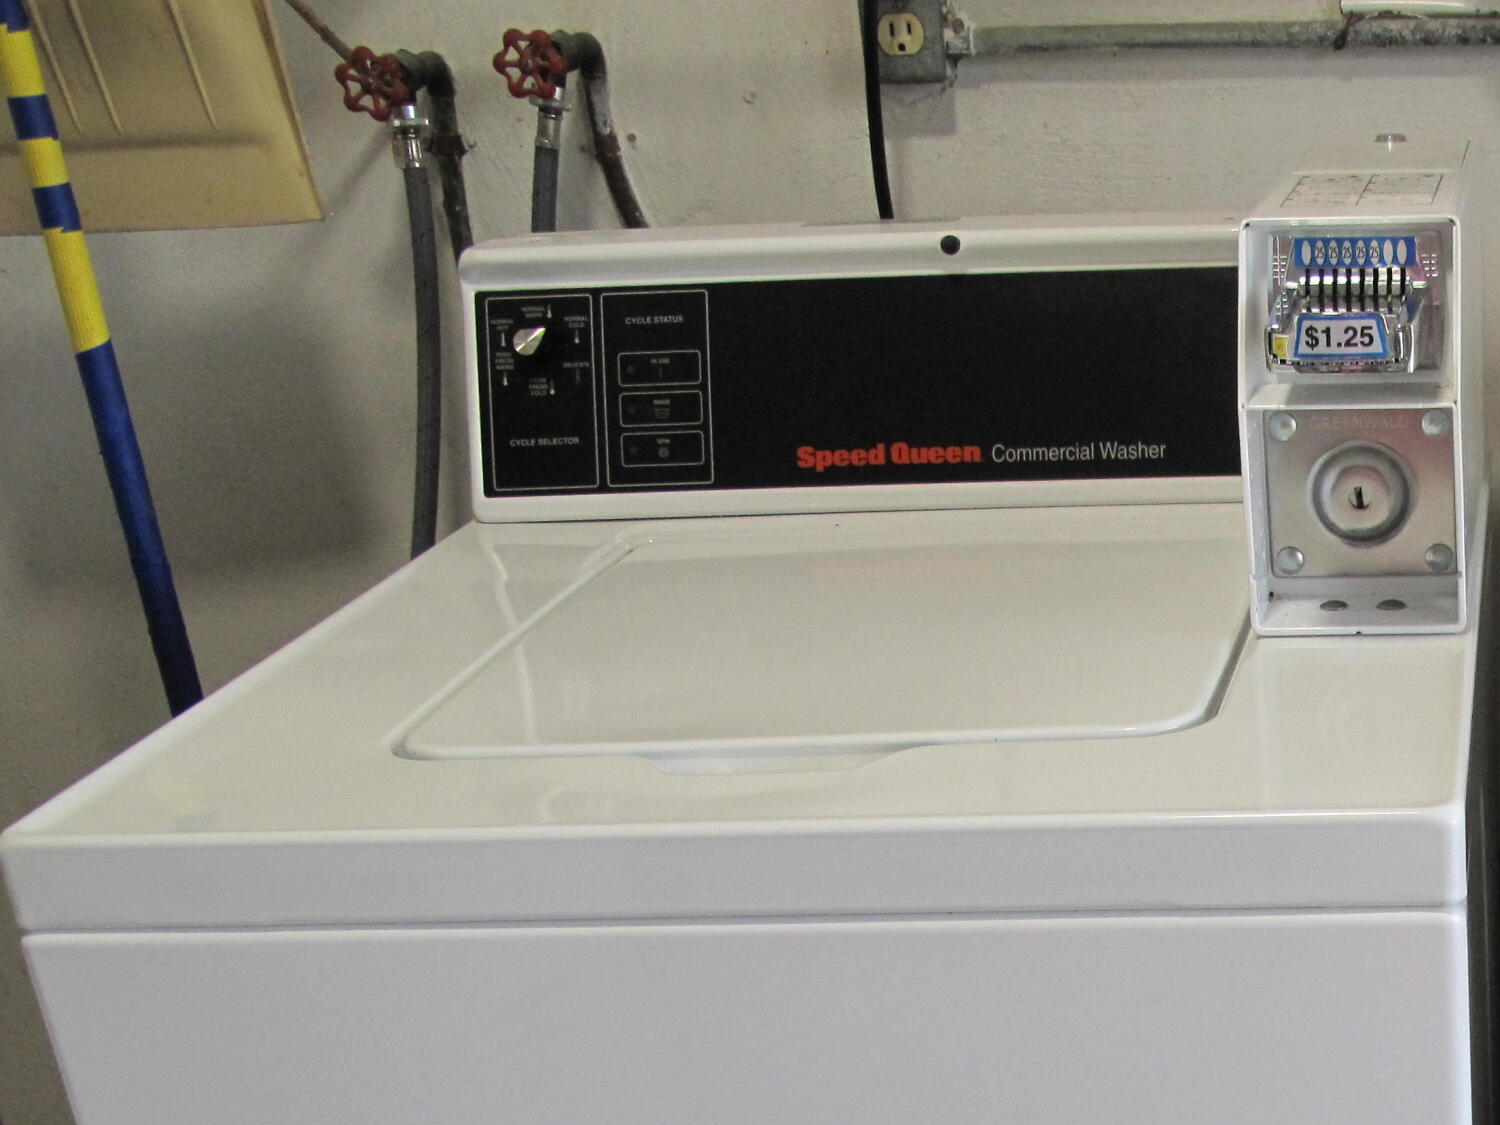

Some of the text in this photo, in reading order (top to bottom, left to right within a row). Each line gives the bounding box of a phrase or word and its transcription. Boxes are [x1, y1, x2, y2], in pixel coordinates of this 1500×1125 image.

[625, 315, 684, 325] CYCLE STATUS
[1304, 325, 1375, 351] $1.25
[1311, 414, 1410, 430] GREENWALD
[510, 437, 580, 447] CYCLE SELECTOR
[796, 441, 1167, 472] Speed Queen Commercial Washer
